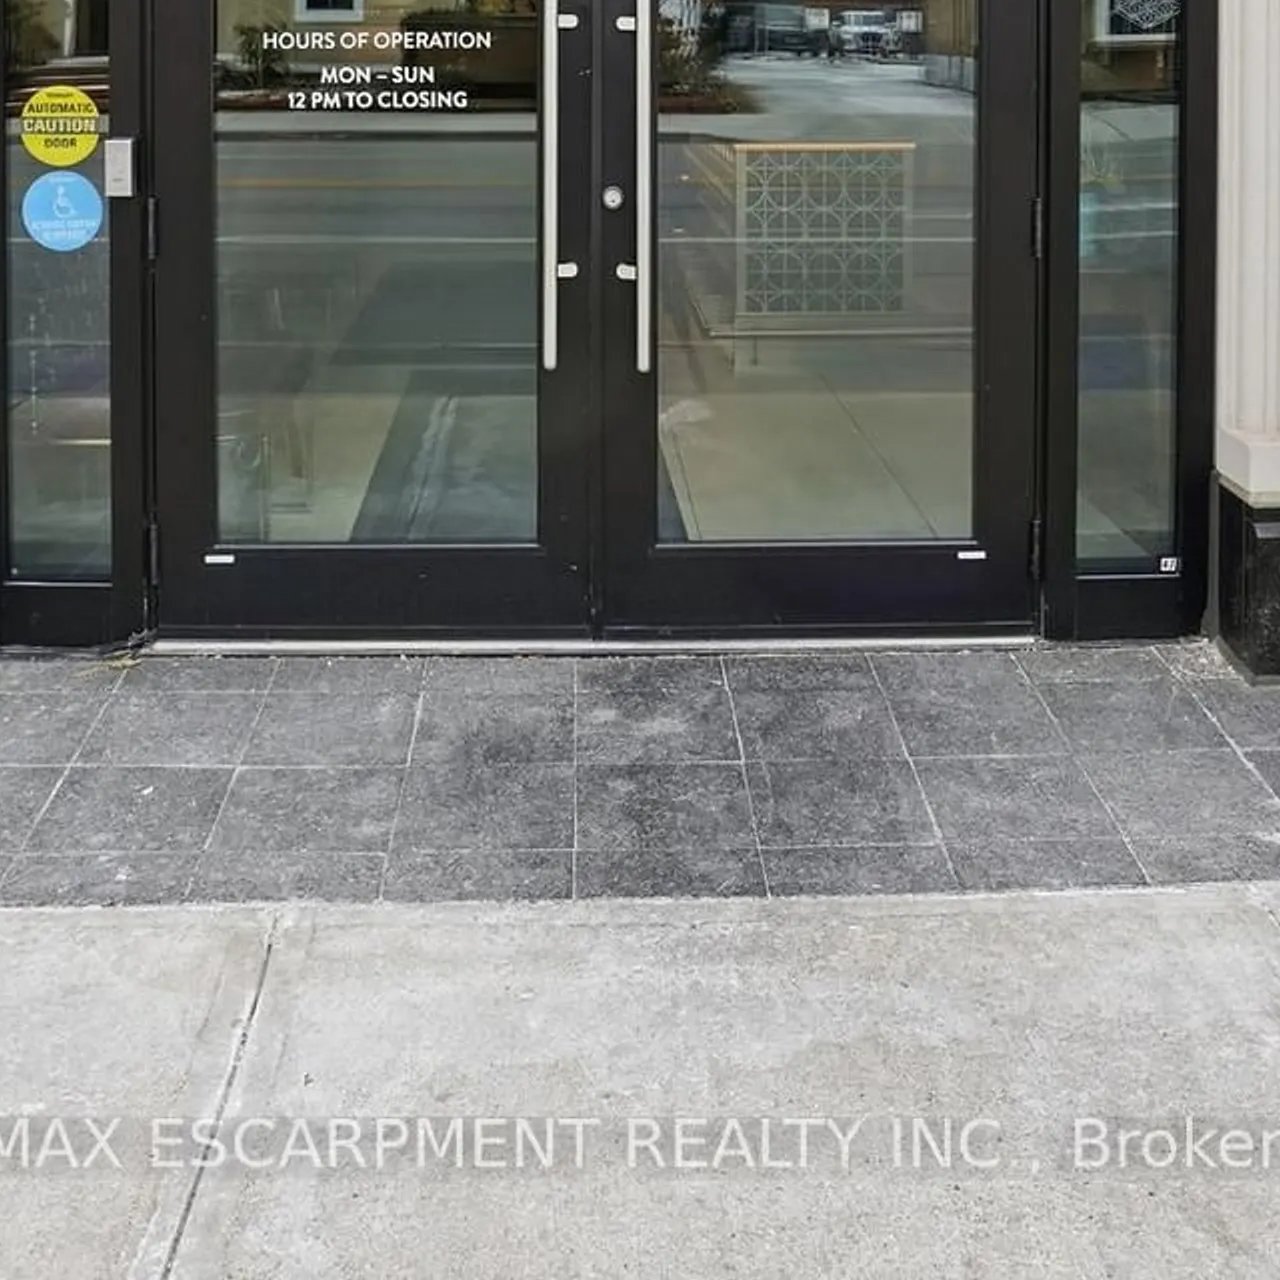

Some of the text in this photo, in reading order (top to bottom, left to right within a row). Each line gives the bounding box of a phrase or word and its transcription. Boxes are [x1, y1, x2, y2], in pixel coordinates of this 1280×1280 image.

[262, 31, 492, 49] HOURS OF OPERATION
[320, 66, 371, 84] MON
[391, 66, 435, 84] SUN
[27, 102, 94, 114] AUTOMATIC
[288, 91, 468, 109] 12 PM TO CLOSING
[23, 117, 97, 133] CAUTION
[43, 137, 78, 149] DOOR
